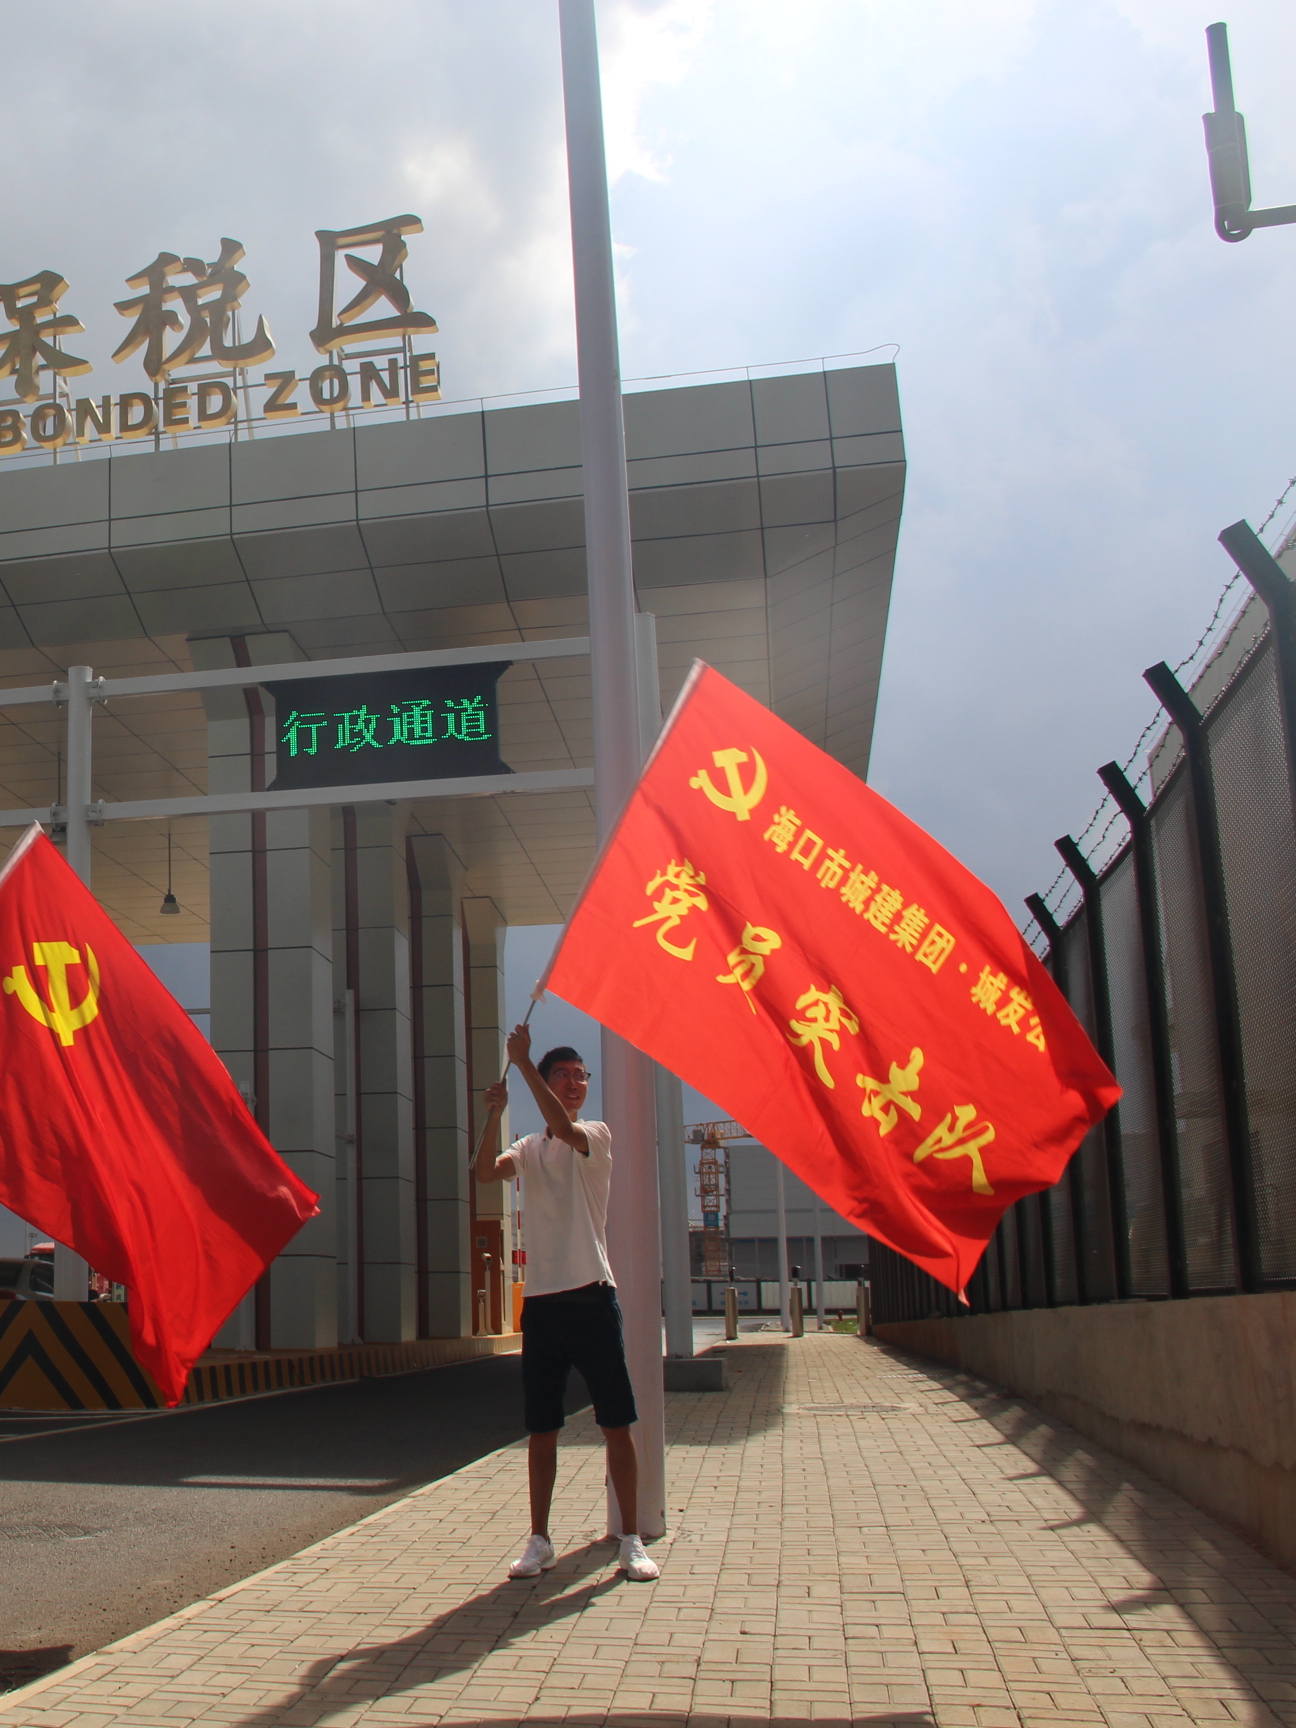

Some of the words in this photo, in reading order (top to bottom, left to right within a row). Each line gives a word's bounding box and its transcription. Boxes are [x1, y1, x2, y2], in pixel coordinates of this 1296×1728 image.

[262, 352, 442, 420] ZONE
[281, 695, 492, 757] 行政通道
